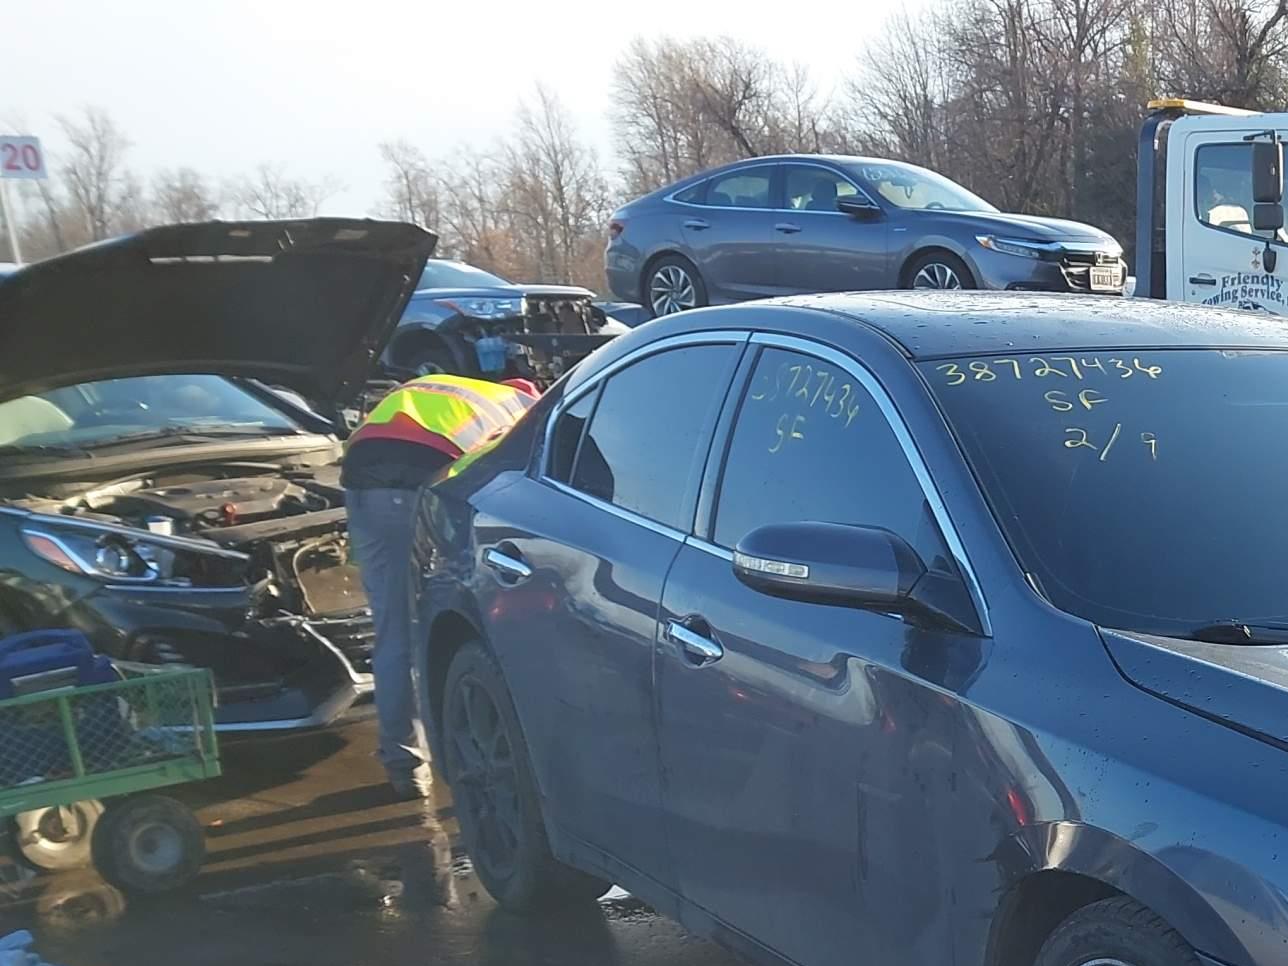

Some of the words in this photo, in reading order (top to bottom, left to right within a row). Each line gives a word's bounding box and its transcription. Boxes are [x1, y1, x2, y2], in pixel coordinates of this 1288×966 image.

[0, 143, 39, 171] 20
[1221, 271, 1284, 291] Friendly
[1240, 285, 1285, 305] Service,
[936, 356, 1162, 386] 38727436
